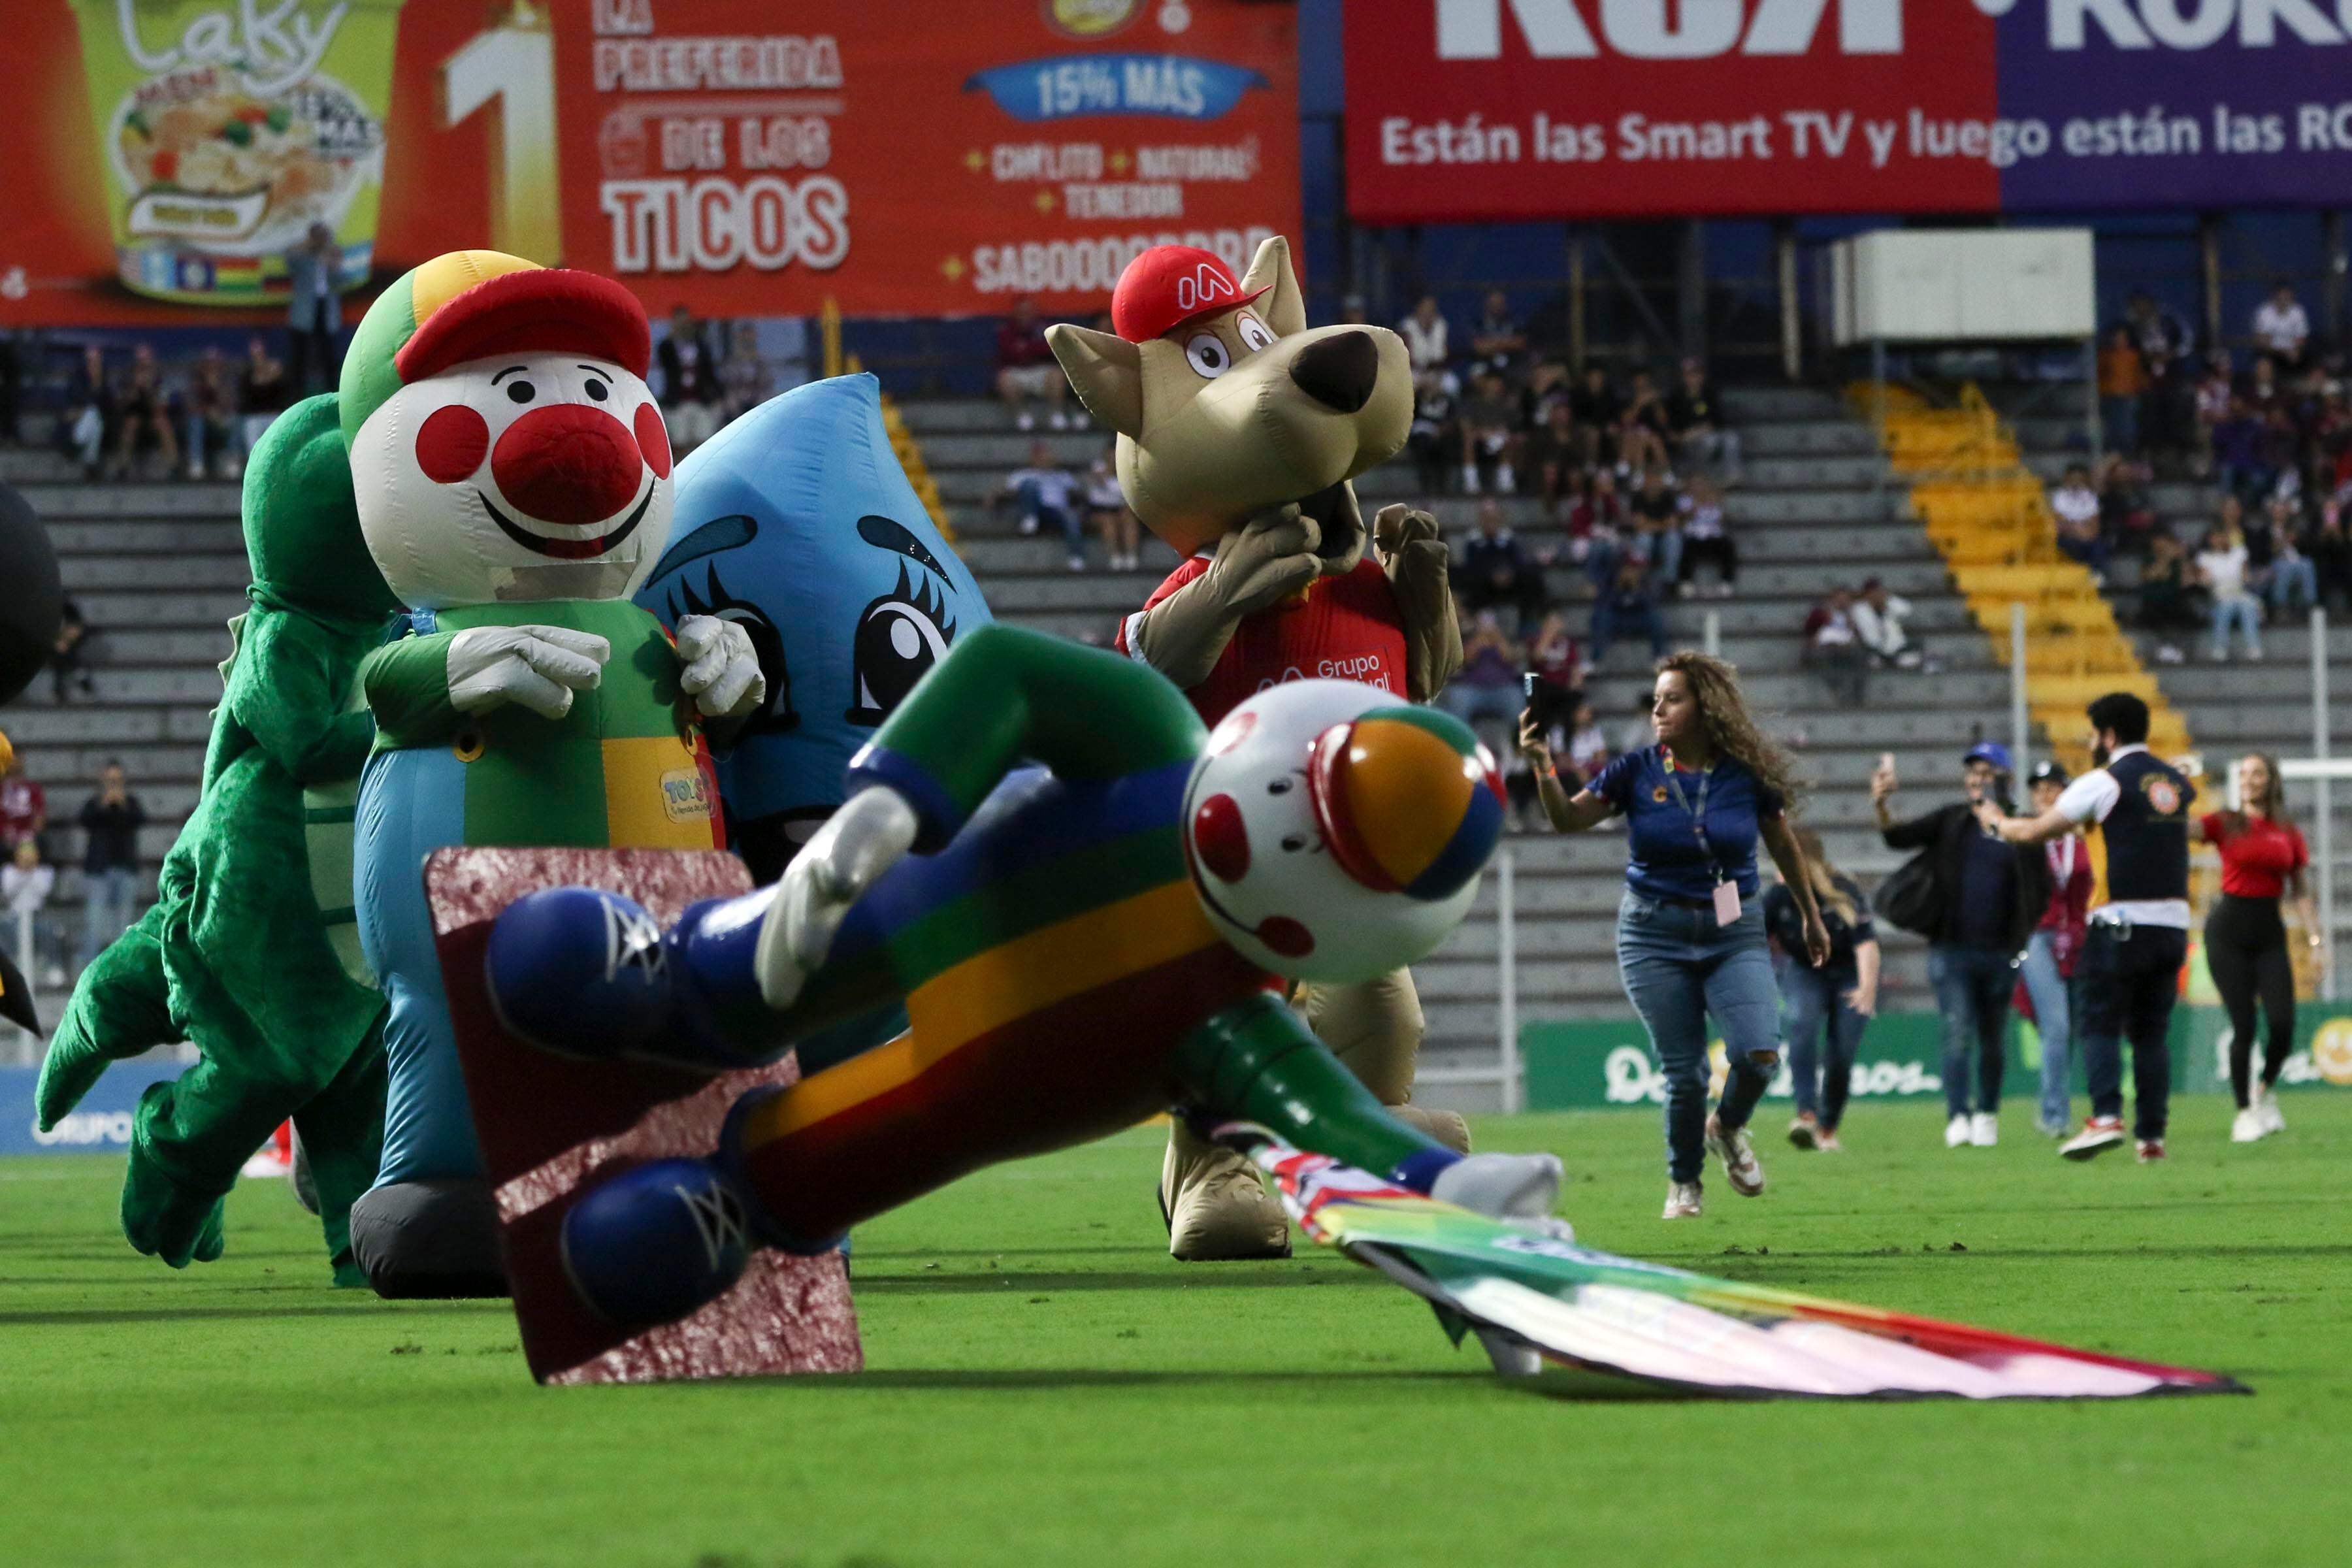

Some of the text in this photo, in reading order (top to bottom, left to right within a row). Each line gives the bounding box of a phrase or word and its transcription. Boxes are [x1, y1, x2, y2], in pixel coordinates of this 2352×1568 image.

[1037, 60, 1117, 117] 15%
[661, 116, 831, 170] DE LOS
[1380, 112, 1521, 165] Están
[1532, 112, 1605, 162] las
[1617, 112, 1772, 161] Smart
[1782, 110, 1854, 158] TV
[1864, 122, 1896, 168] y
[1908, 107, 2051, 168] luego
[2062, 105, 2202, 156] están
[2214, 103, 2285, 154] las
[600, 176, 849, 272] TICOS
[1318, 655, 1379, 679] Grupo
[1605, 1045, 1667, 1102] Do
